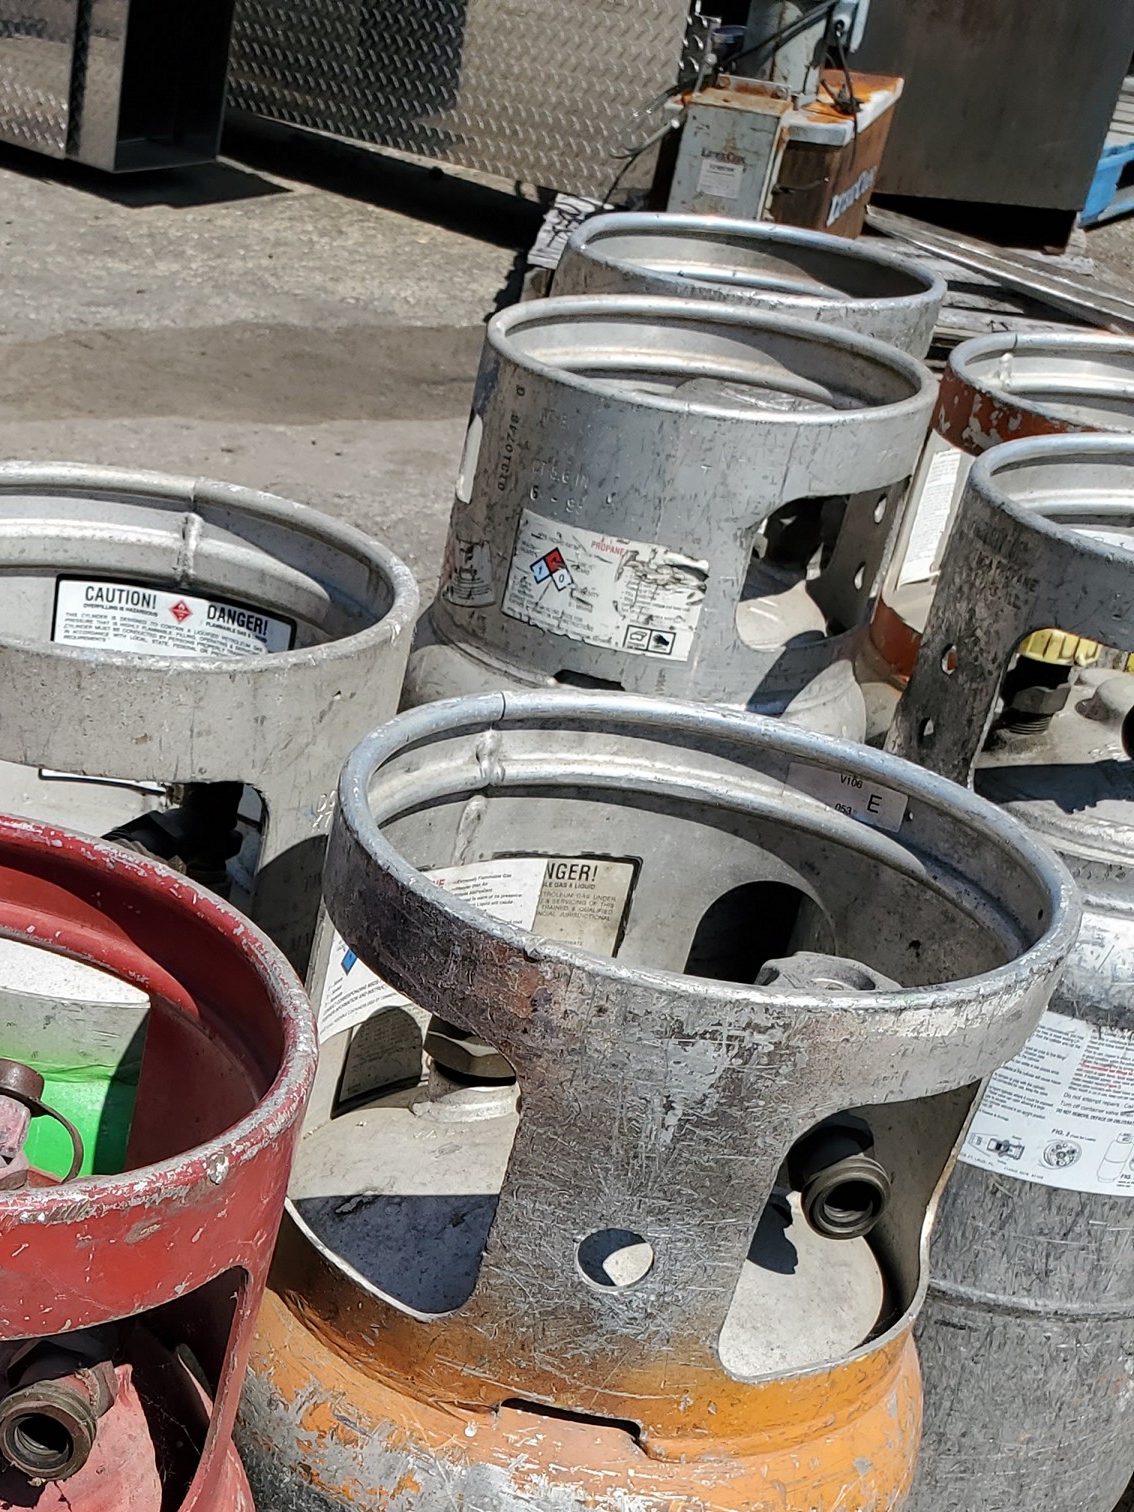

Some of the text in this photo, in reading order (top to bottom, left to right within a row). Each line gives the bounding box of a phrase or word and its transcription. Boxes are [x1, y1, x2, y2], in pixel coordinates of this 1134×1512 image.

[591, 540, 625, 557] PROPANE
[84, 585, 157, 609] CAUTION!
[207, 604, 268, 636] DANGER!
[840, 774, 863, 789] V106
[867, 794, 882, 814] E
[546, 863, 598, 881] NGER!
